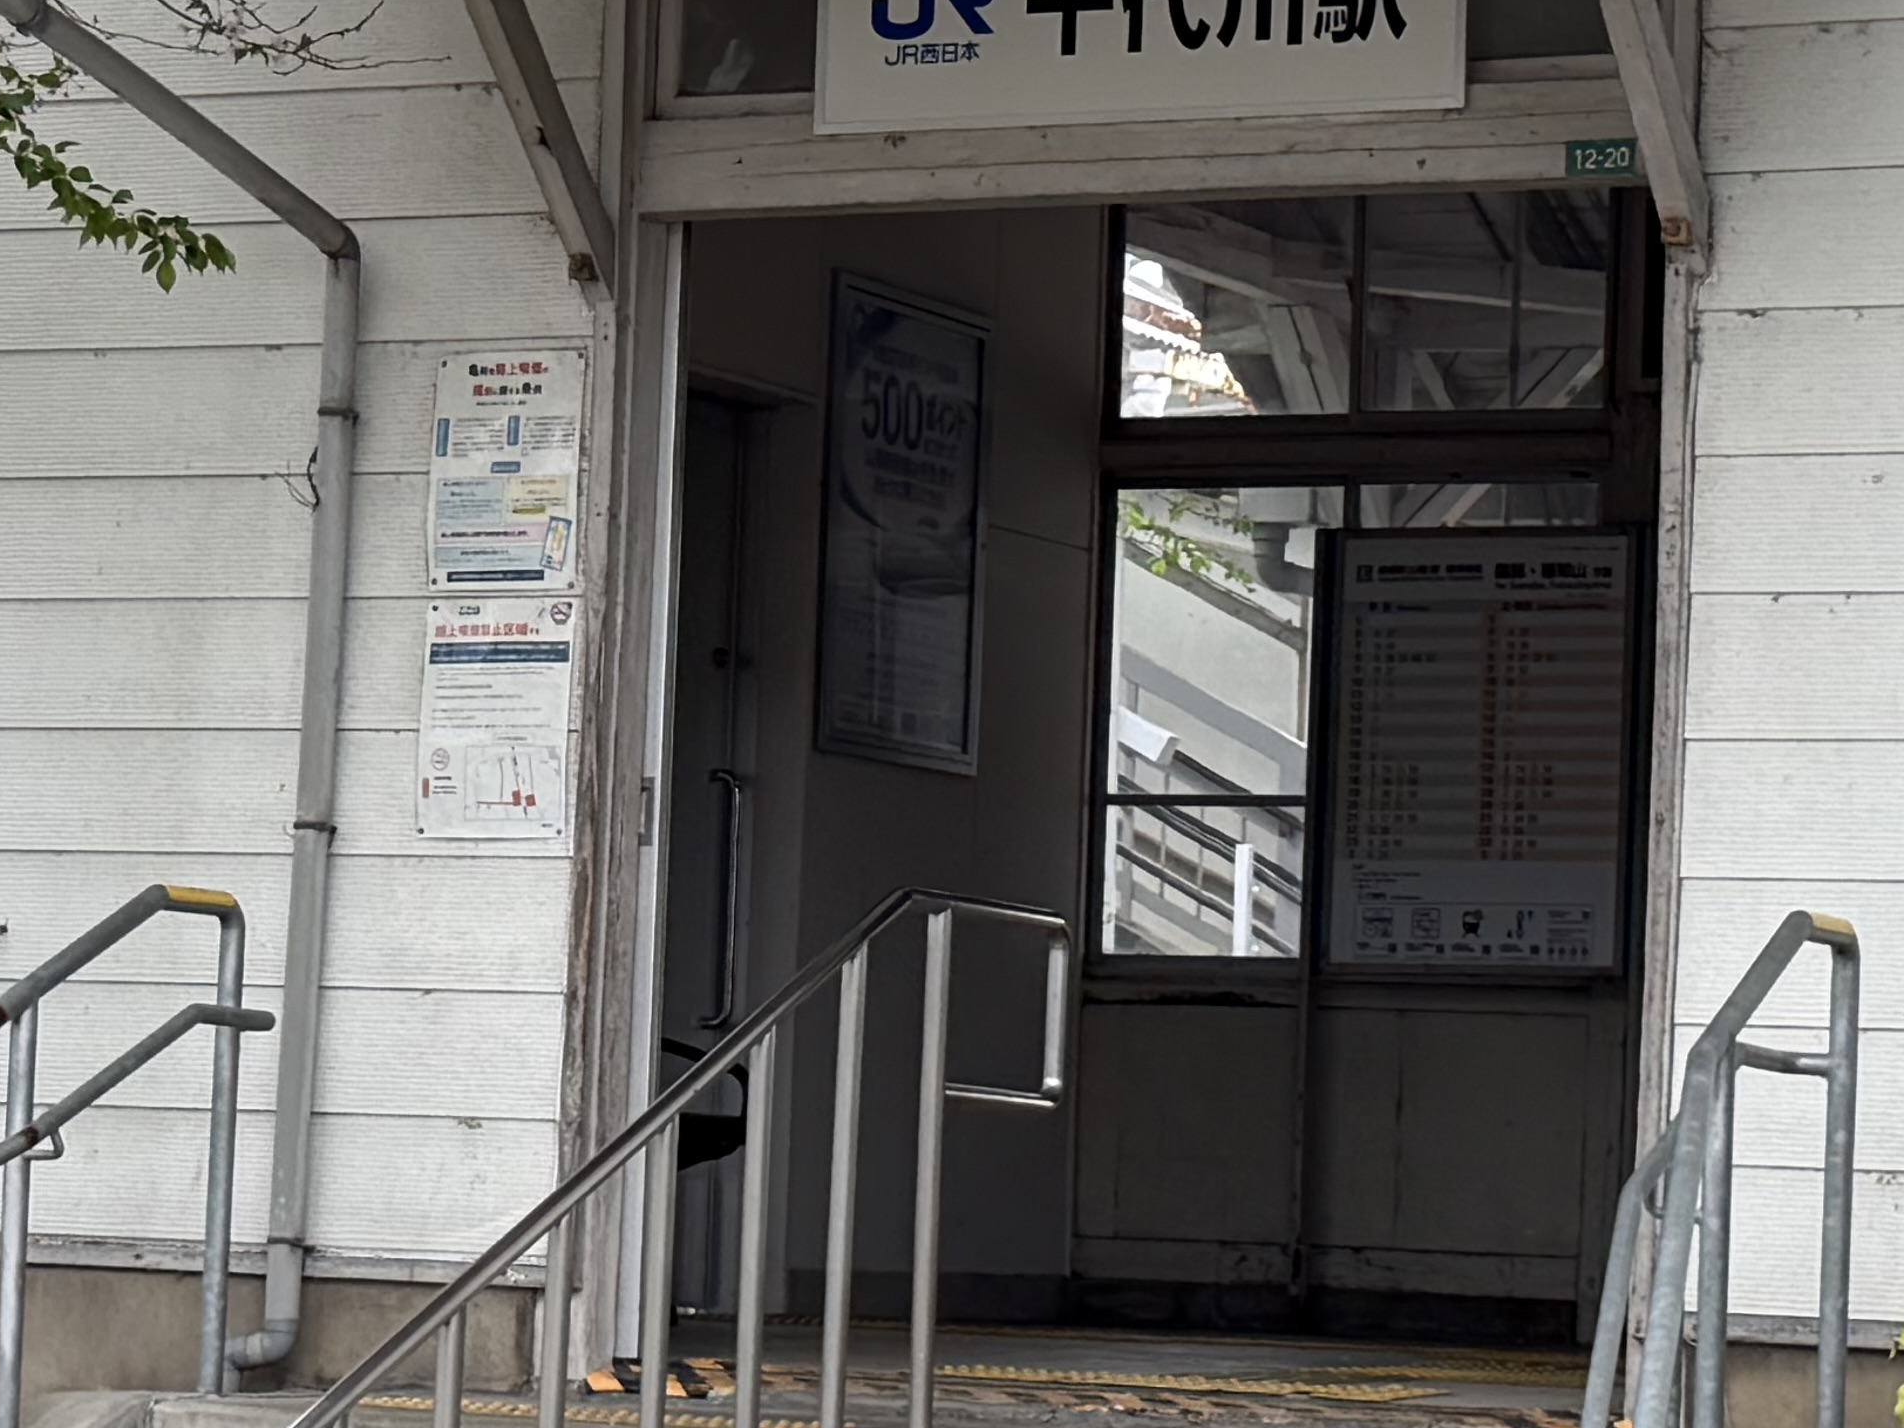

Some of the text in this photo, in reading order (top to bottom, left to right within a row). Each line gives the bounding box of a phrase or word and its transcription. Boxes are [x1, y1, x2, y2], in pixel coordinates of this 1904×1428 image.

[884, 40, 981, 67] JR西日本
[1574, 146, 1630, 170] 12-20
